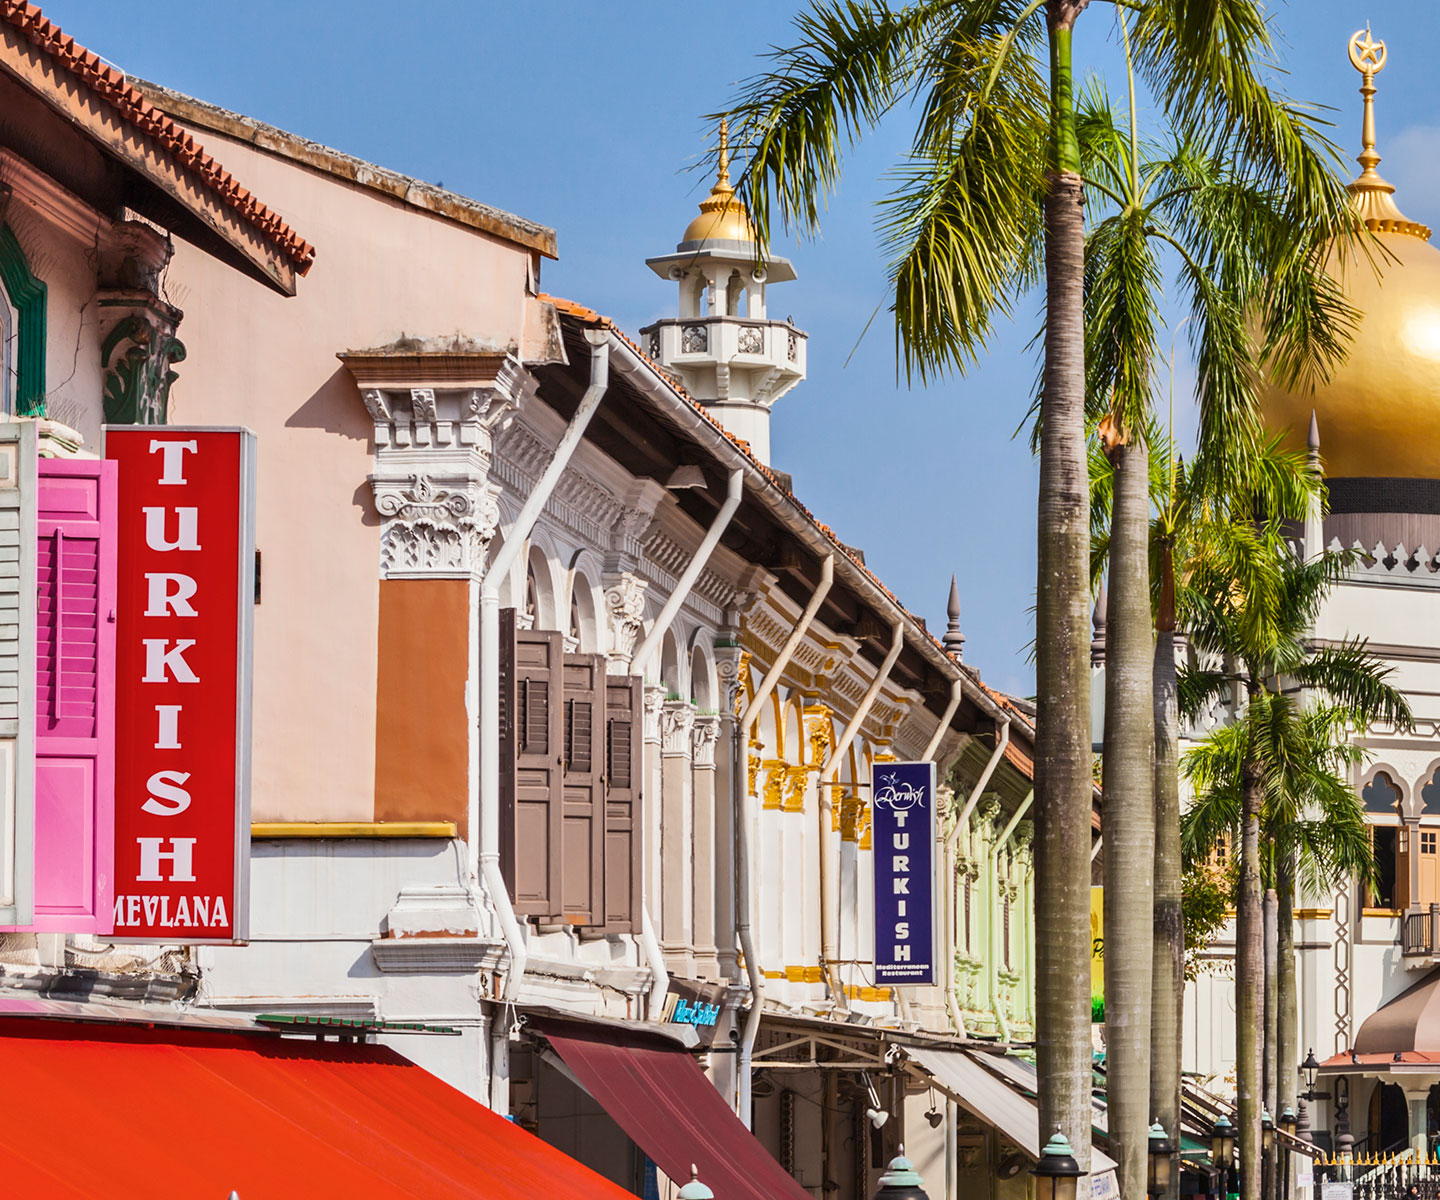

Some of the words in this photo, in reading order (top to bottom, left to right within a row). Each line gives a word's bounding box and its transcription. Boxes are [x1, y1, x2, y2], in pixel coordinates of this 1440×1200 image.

[135, 439, 201, 882] TURKISH
[113, 895, 229, 928] MEVLANA
[892, 811, 911, 961] TURKISH
